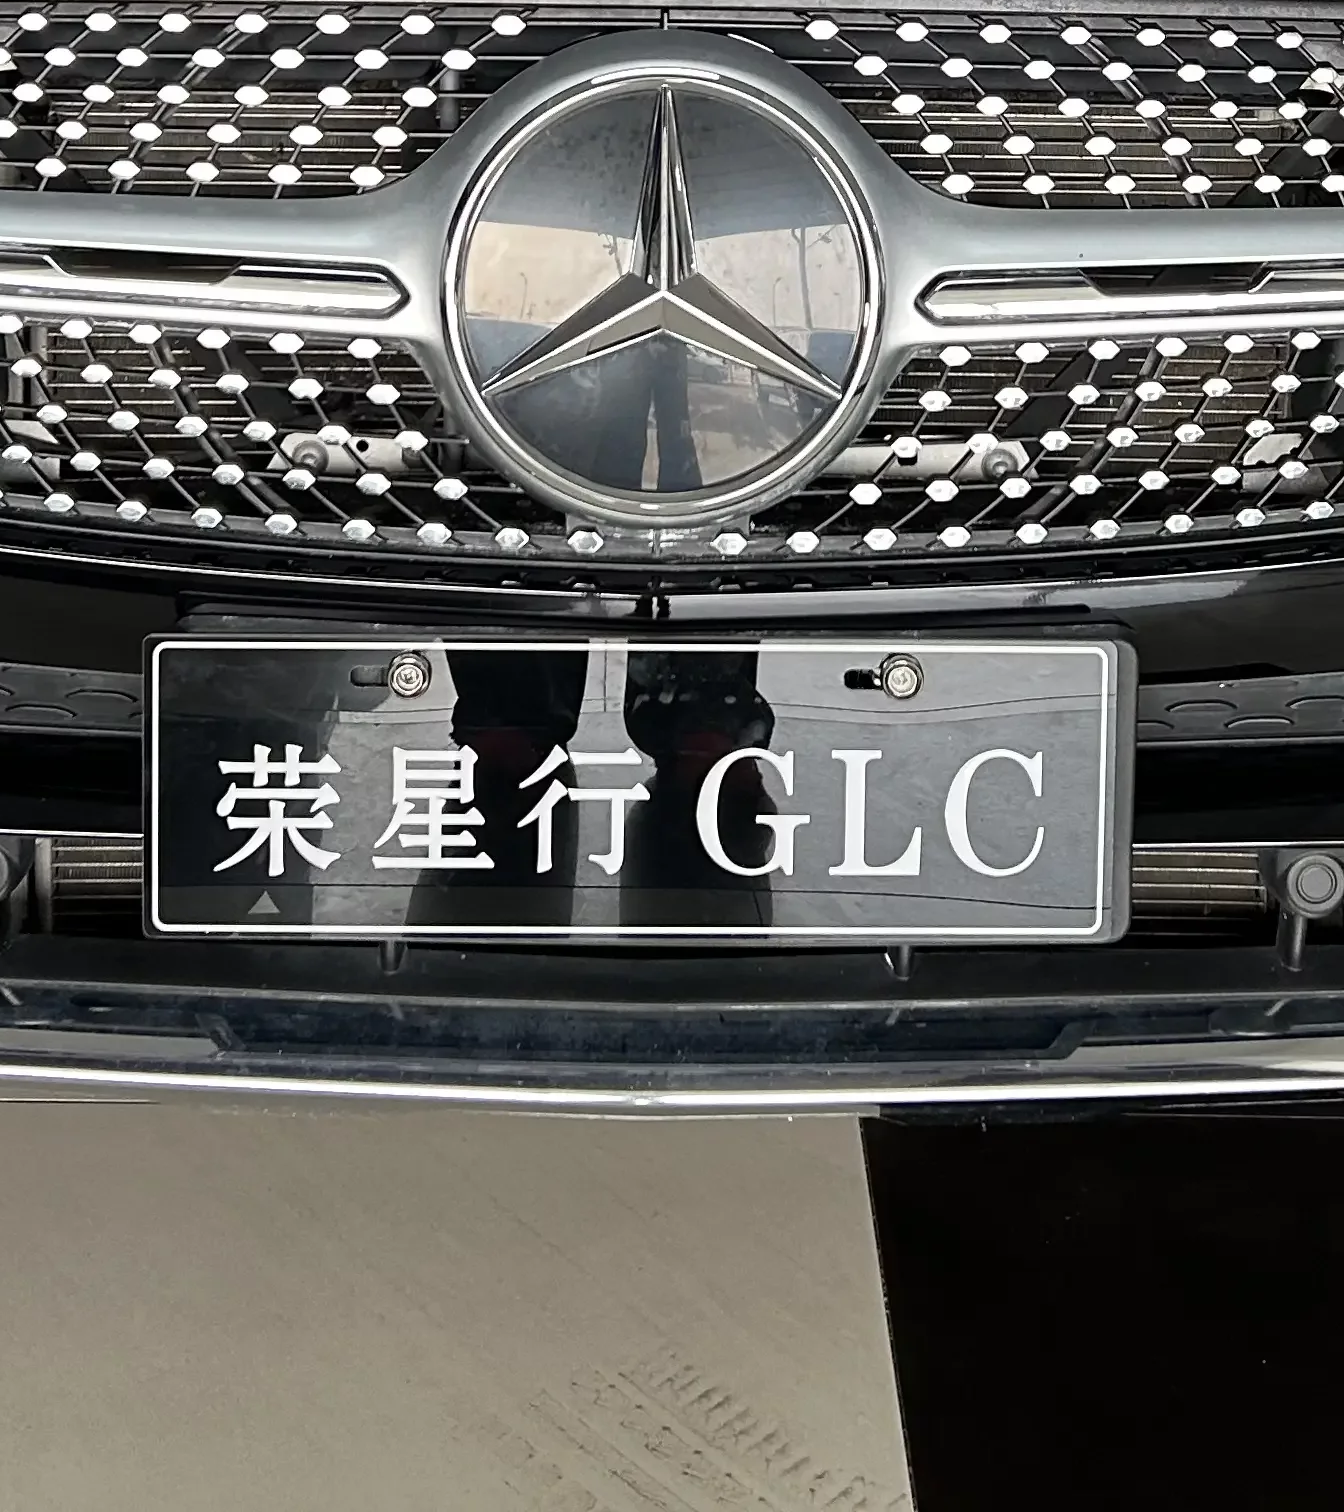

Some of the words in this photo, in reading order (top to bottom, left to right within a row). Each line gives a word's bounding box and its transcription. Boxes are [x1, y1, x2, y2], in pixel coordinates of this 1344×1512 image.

[213, 742, 652, 878] 荣星行
[696, 746, 1046, 878] GLC
